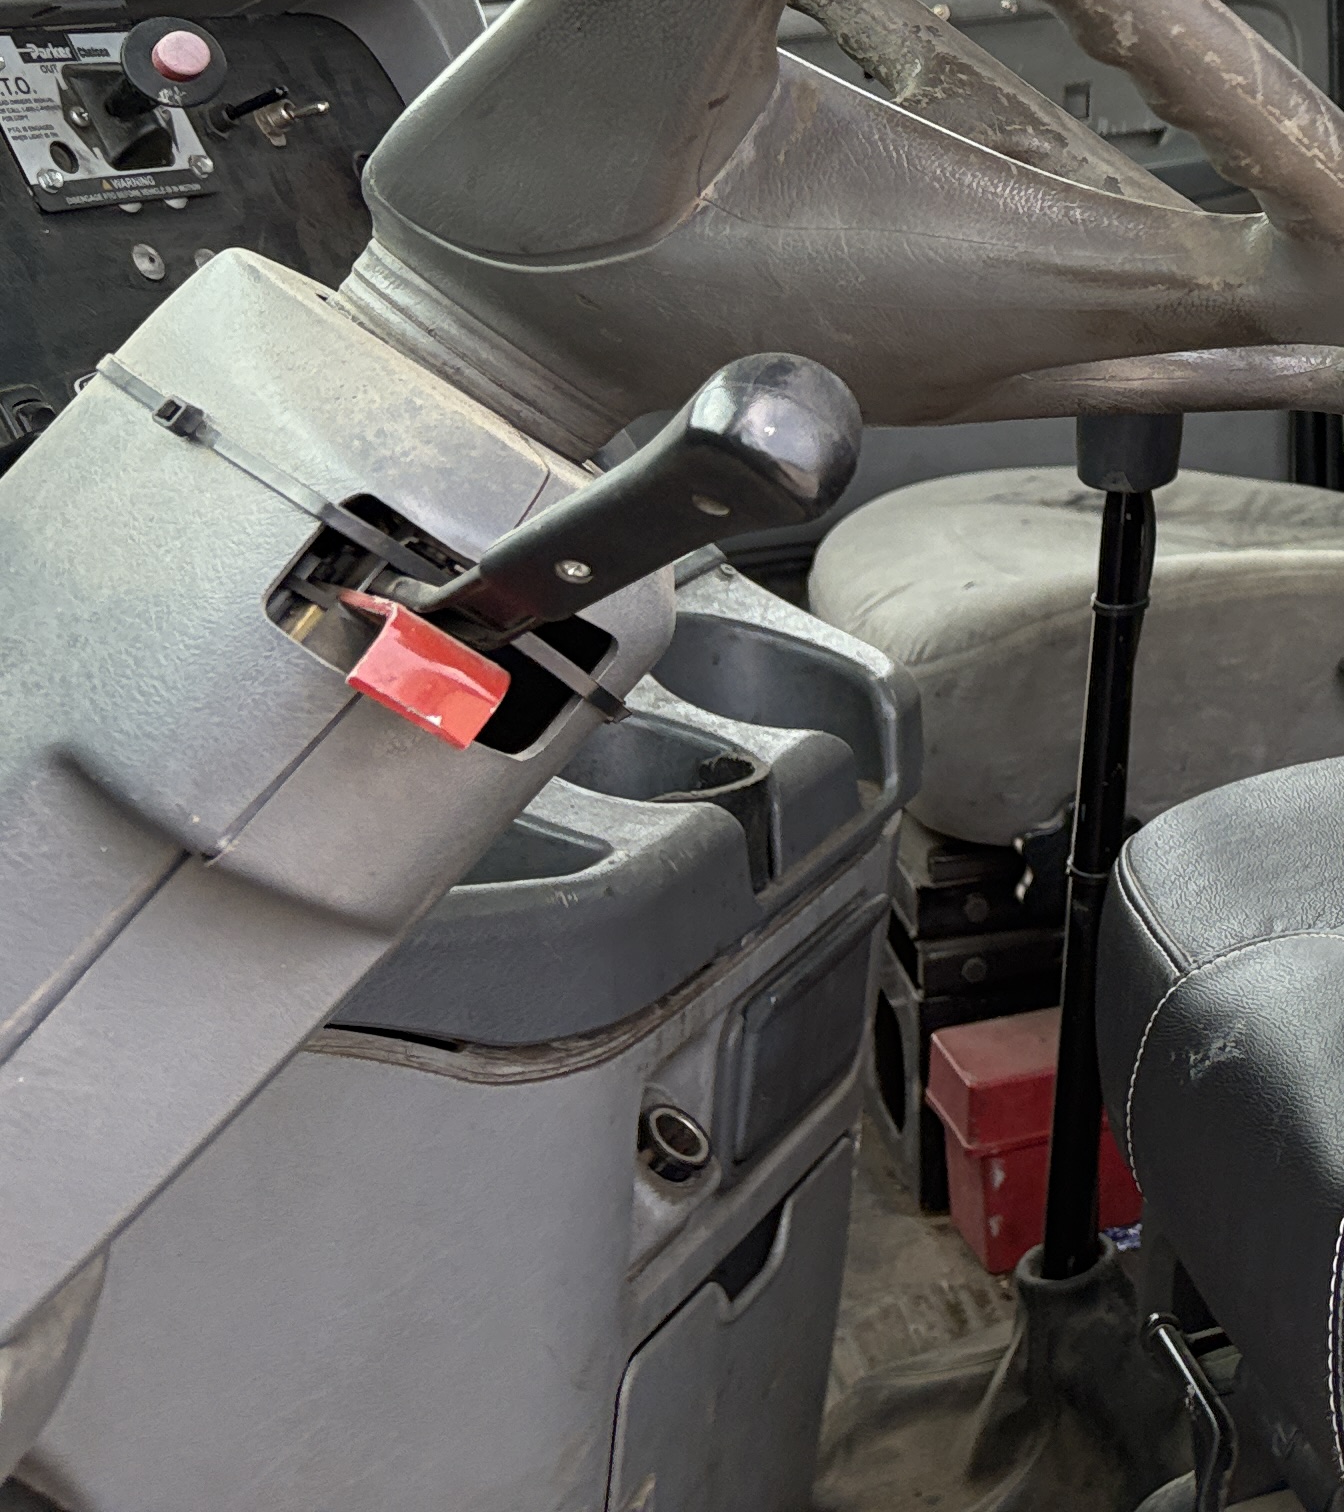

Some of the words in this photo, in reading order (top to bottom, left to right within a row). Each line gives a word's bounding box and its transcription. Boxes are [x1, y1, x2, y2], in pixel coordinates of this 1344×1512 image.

[26, 42, 74, 60] Parker
[40, 64, 59, 74] OUT
[110, 174, 156, 190] WARNING
